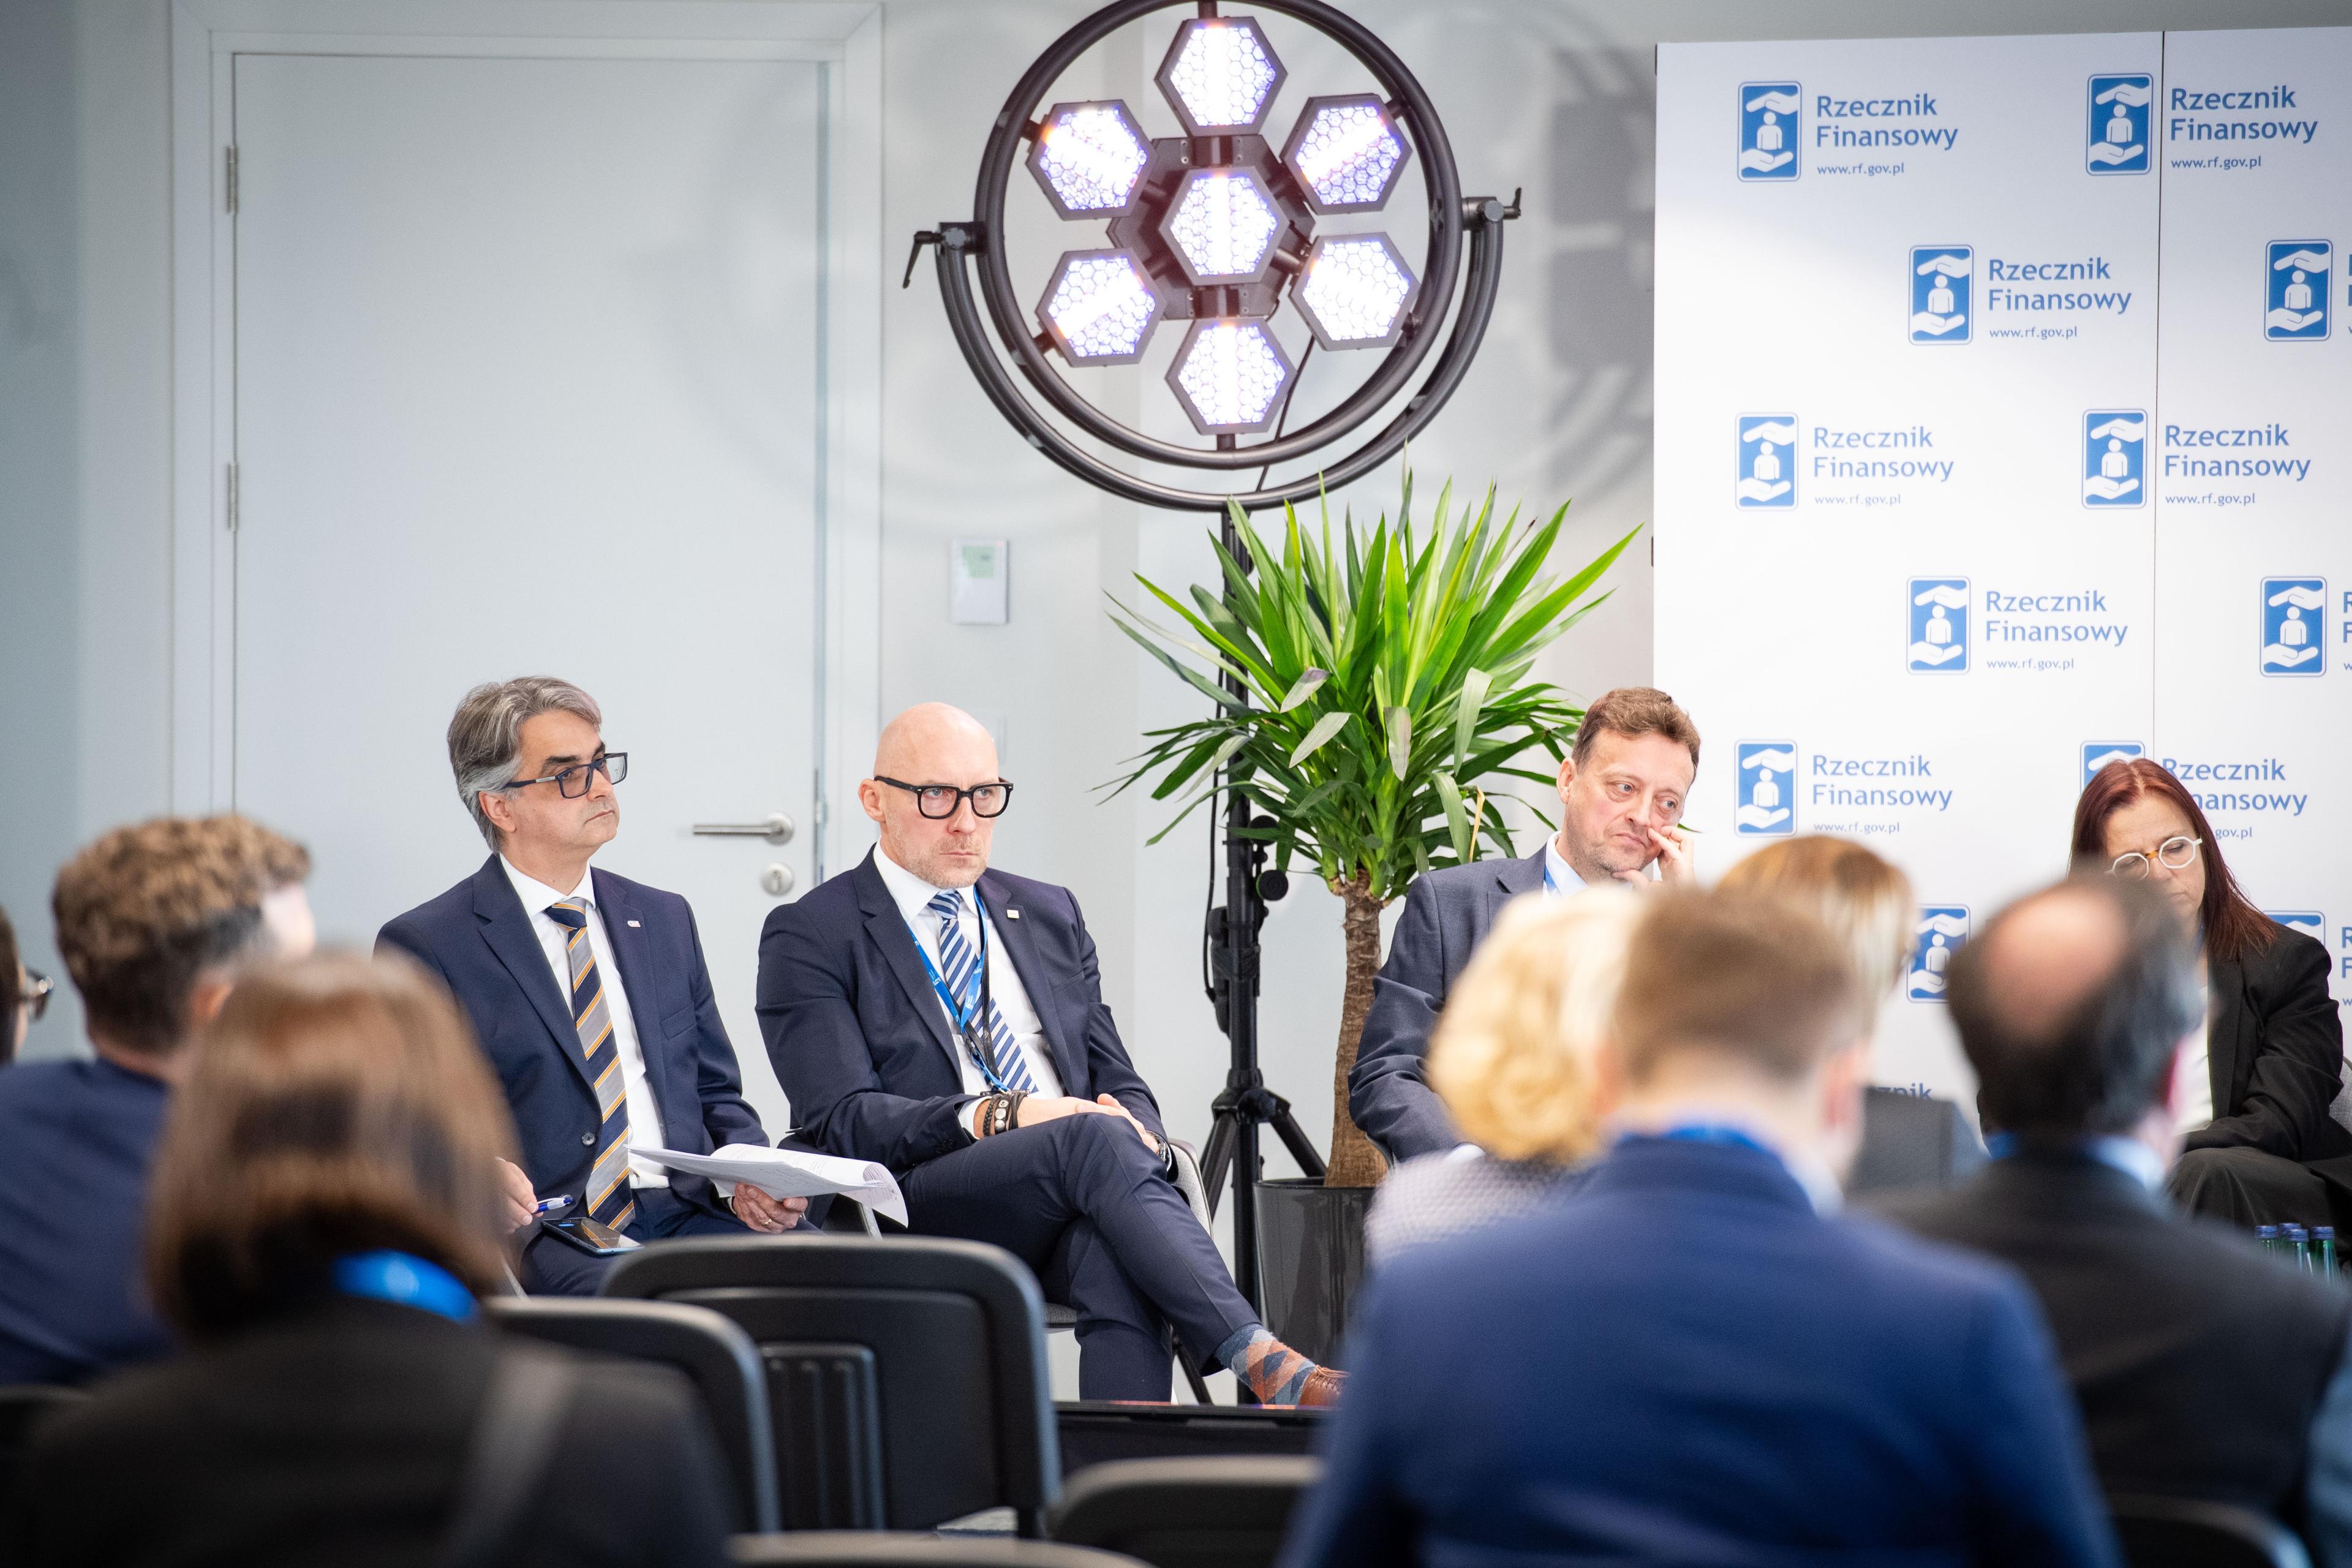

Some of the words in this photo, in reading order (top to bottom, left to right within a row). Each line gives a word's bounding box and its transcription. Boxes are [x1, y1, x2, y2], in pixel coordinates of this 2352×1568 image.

[1817, 93, 1937, 117] Rzecznik
[2172, 85, 2296, 110] Rzecznik
[1817, 126, 1958, 151] Finansowy
[2171, 118, 2318, 144] Finansowy
[1817, 162, 1904, 176] www.rf.gov.pl
[2171, 156, 2261, 170] www.rf.gov.pl
[1989, 257, 2110, 281] Rzecznik
[1989, 289, 2132, 314] Finansowy
[1989, 326, 2077, 340] www.rf.gov.pl
[1814, 426, 1932, 448] Rzecznik
[2166, 424, 2288, 447] Rzecznik
[1814, 457, 1954, 482] Finansowy
[2166, 455, 2310, 481] Finansowy
[1815, 494, 1901, 506] www.rf.gov.pl
[2166, 492, 2255, 506] www.rf.gov.pl
[1987, 590, 2106, 611] Rzecznik
[1986, 620, 2128, 646] Finansowy
[1987, 658, 2073, 671] www.rf.gov.pl
[1813, 755, 1931, 776] Rzecznik
[1813, 785, 1953, 811] Finansowy
[2192, 793, 2308, 816] nansowy
[1814, 822, 1900, 835] www.rf.gov.pl
